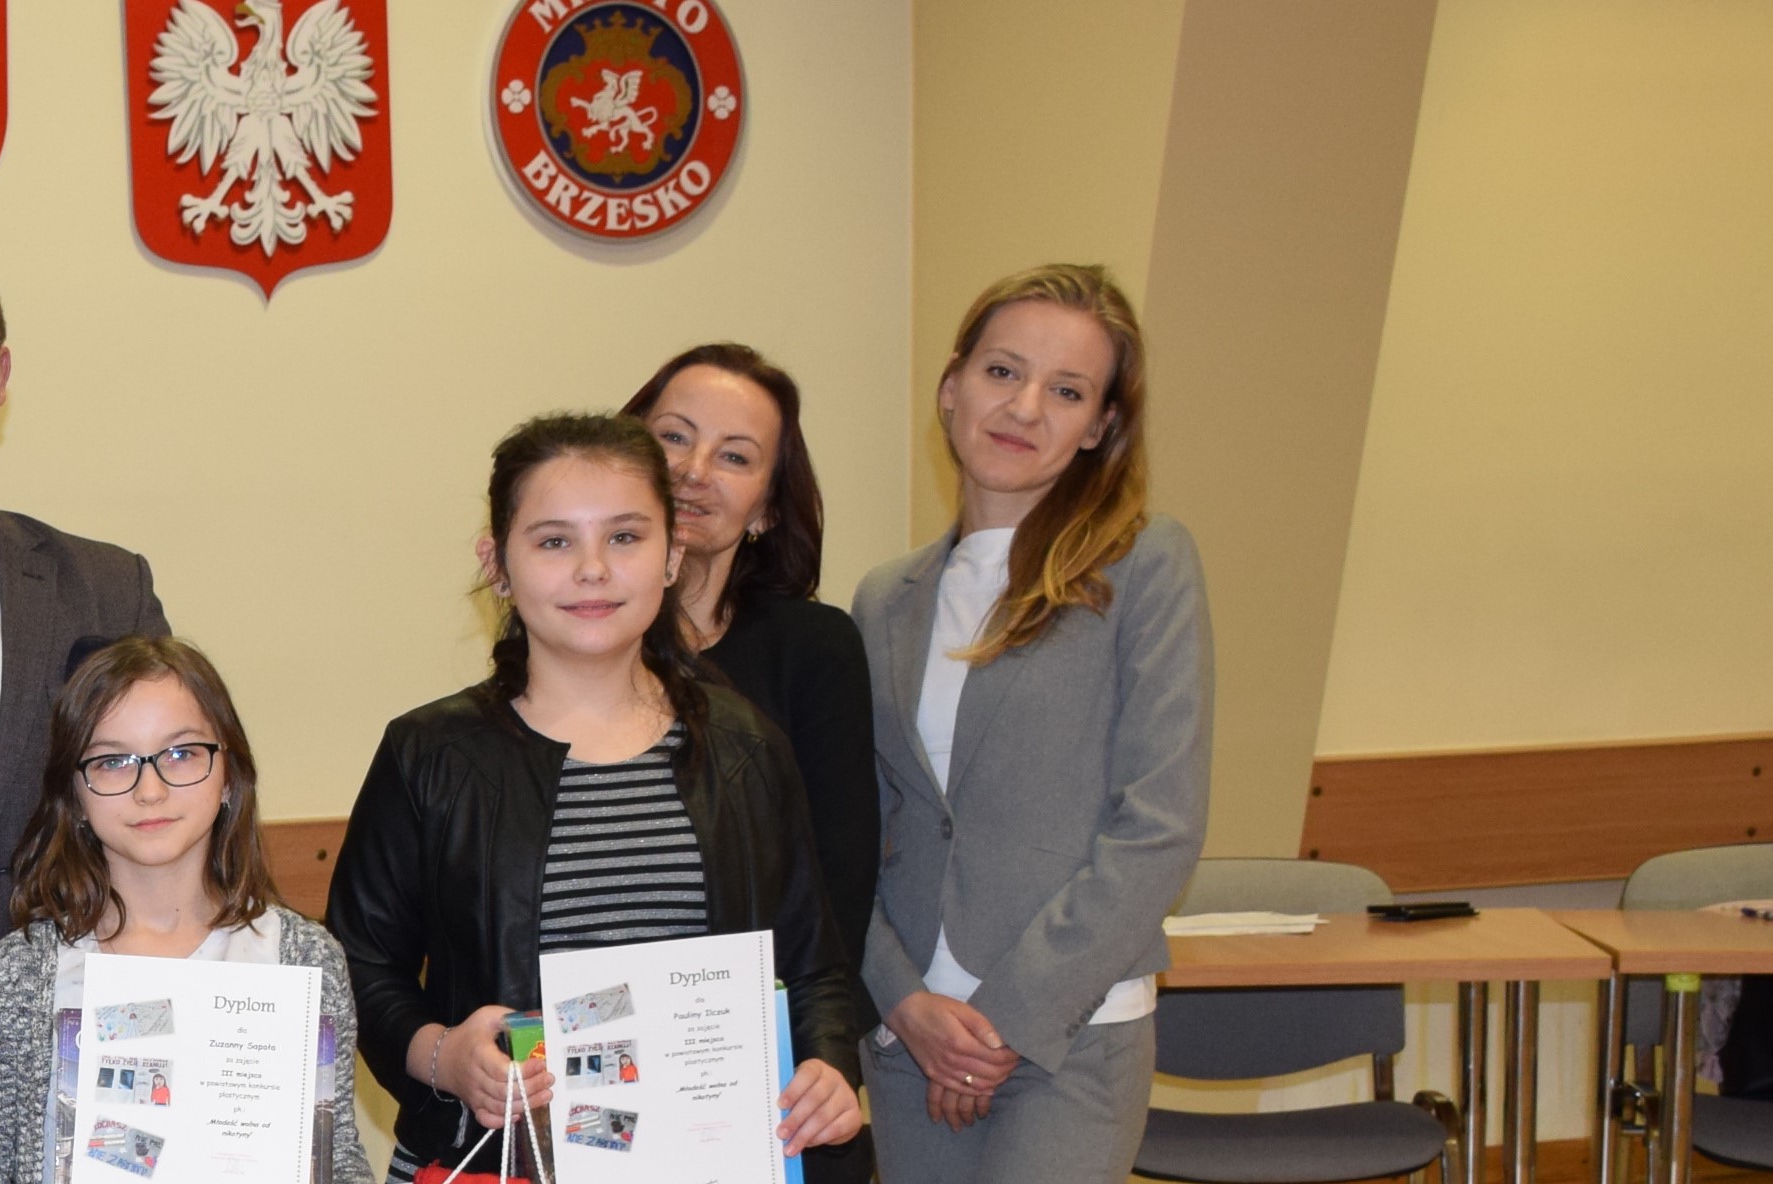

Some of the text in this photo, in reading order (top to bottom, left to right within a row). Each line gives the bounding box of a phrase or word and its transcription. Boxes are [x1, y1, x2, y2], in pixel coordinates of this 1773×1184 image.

[522, 150, 711, 231] BRZESKO
[669, 968, 730, 987] Dyplom
[213, 995, 276, 1014] Dyplom
[209, 1039, 244, 1051] Zuzanny
